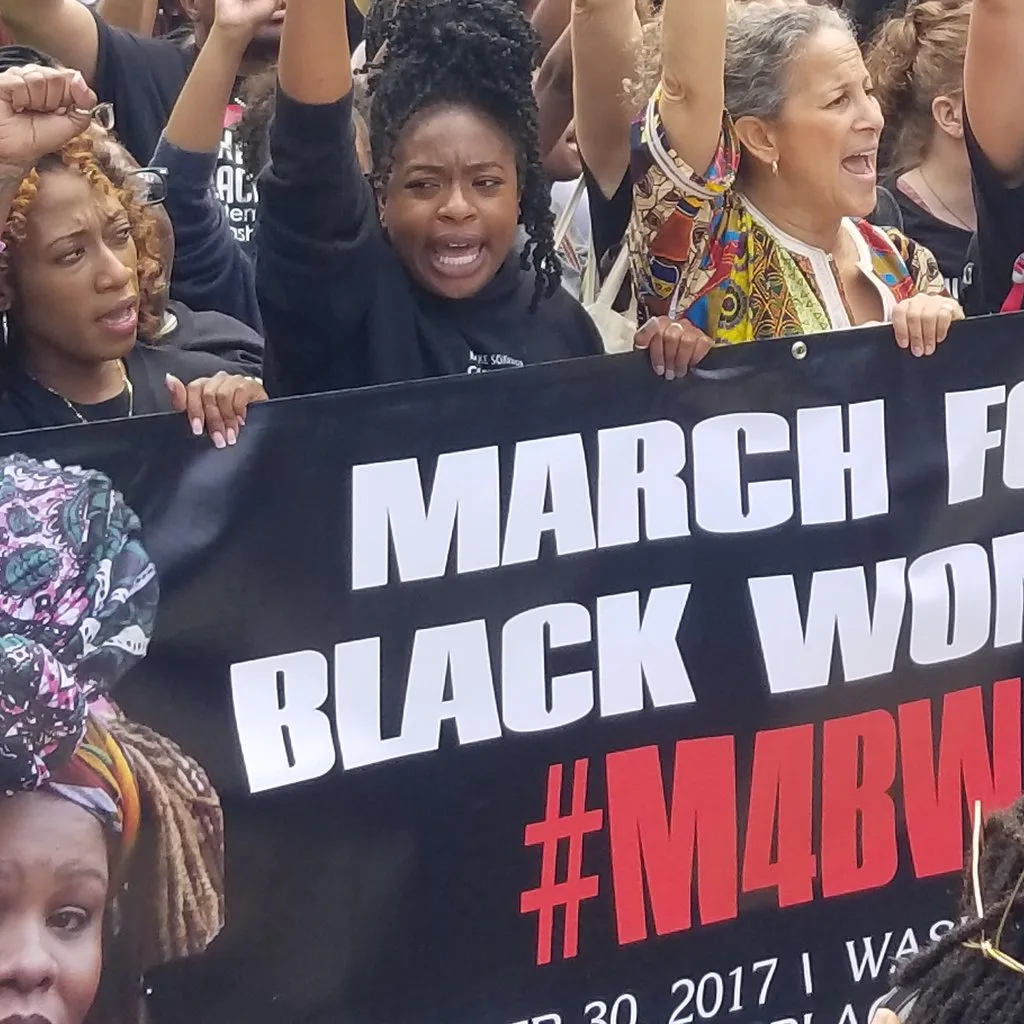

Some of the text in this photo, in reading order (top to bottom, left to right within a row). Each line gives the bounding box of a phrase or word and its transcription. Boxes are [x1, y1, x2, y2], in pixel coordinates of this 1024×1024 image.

[350, 398, 890, 590] MARCH
[229, 583, 694, 793] BLACK
[520, 677, 1022, 965] #M4BW
[669, 957, 779, 1024] 2017
